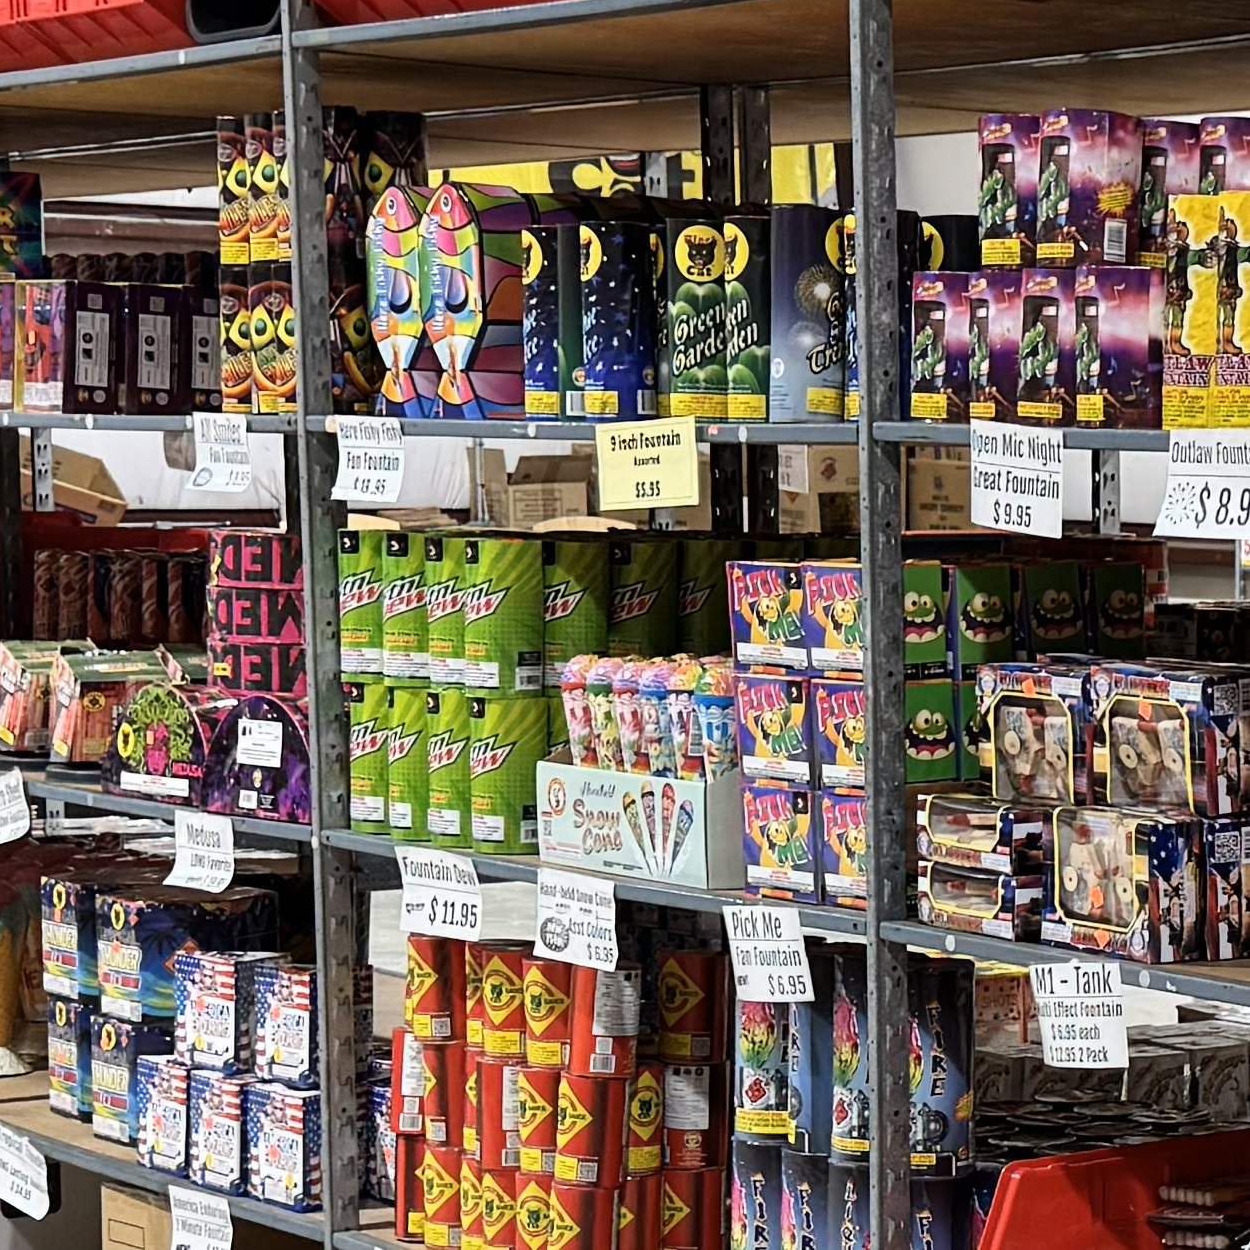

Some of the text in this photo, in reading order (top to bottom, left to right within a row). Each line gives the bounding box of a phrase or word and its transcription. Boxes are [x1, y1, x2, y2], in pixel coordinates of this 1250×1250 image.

[674, 301, 726, 345] Green
[672, 328, 726, 375] Garde
[200, 417, 242, 444] All Smiles
[339, 421, 403, 446] Here Fishy Fishy
[610, 429, 681, 451] 9 inch Fountain
[347, 451, 400, 472] Fan Fountain
[972, 429, 1062, 467] Open Mic Night
[1171, 439, 1213, 465] Outlaw
[973, 466, 1060, 500] Great Fountain
[1195, 481, 1211, 529] $
[186, 822, 221, 849] Medusa
[402, 855, 477, 887] Fountain Dew
[732, 909, 782, 939] Pick Me
[736, 944, 802, 967] Fan Fountain
[1035, 966, 1055, 994] M1
[1073, 963, 1113, 994] Tank
[1053, 1000, 1123, 1018] Effect Fountain
[1079, 1023, 1100, 1040] each
[1079, 1047, 1084, 1062] 2
[1087, 1046, 1109, 1063] Pack
